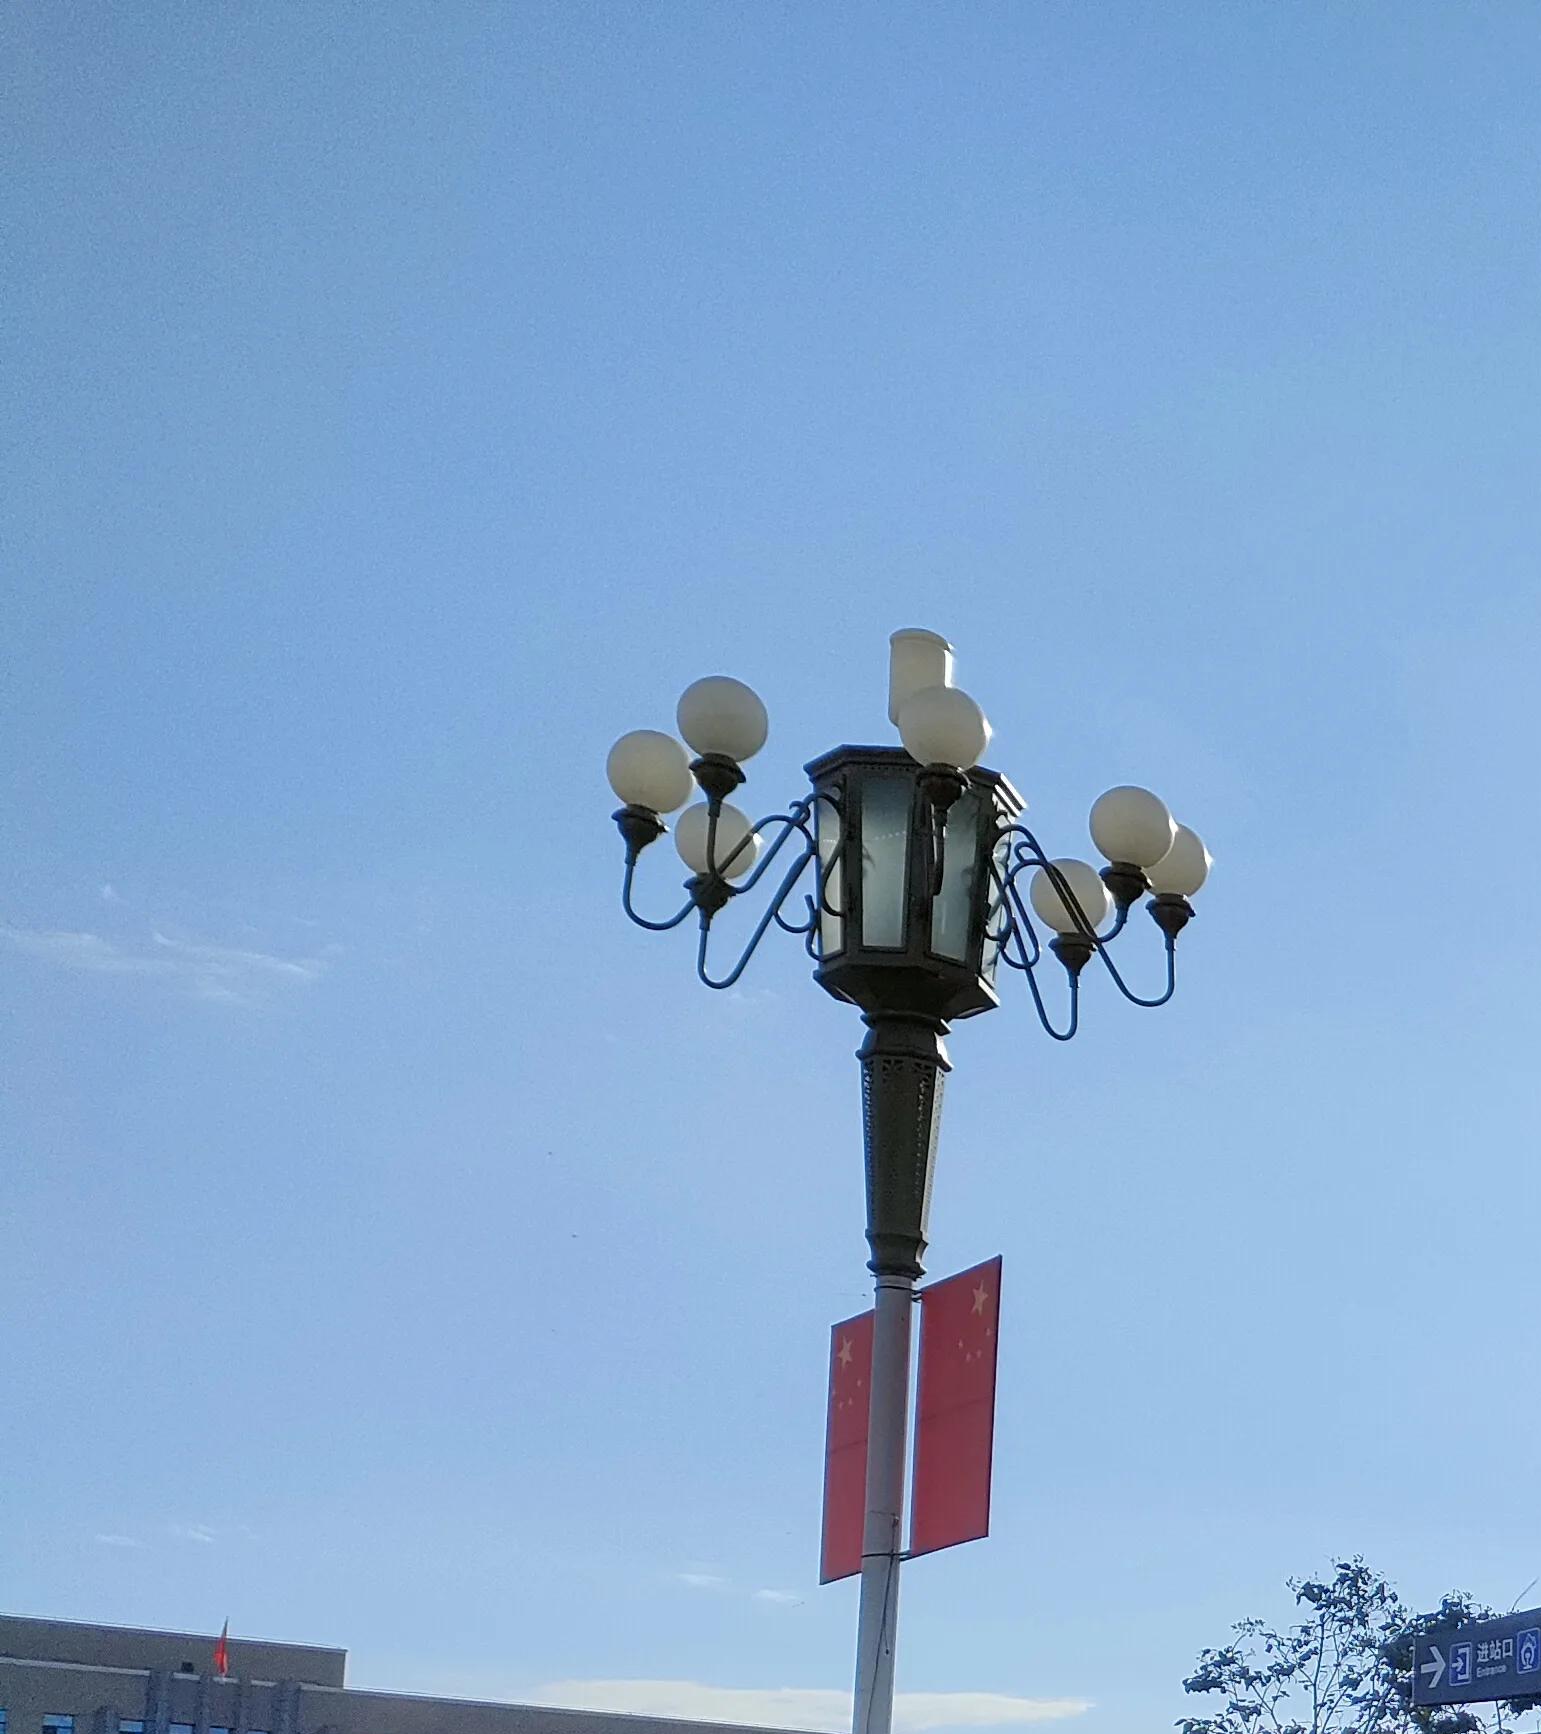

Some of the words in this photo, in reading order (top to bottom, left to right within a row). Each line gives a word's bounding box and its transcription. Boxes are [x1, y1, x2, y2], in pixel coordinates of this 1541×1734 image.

[1476, 1638, 1513, 1663] 进站口
[1476, 1664, 1507, 1678] Entrance
